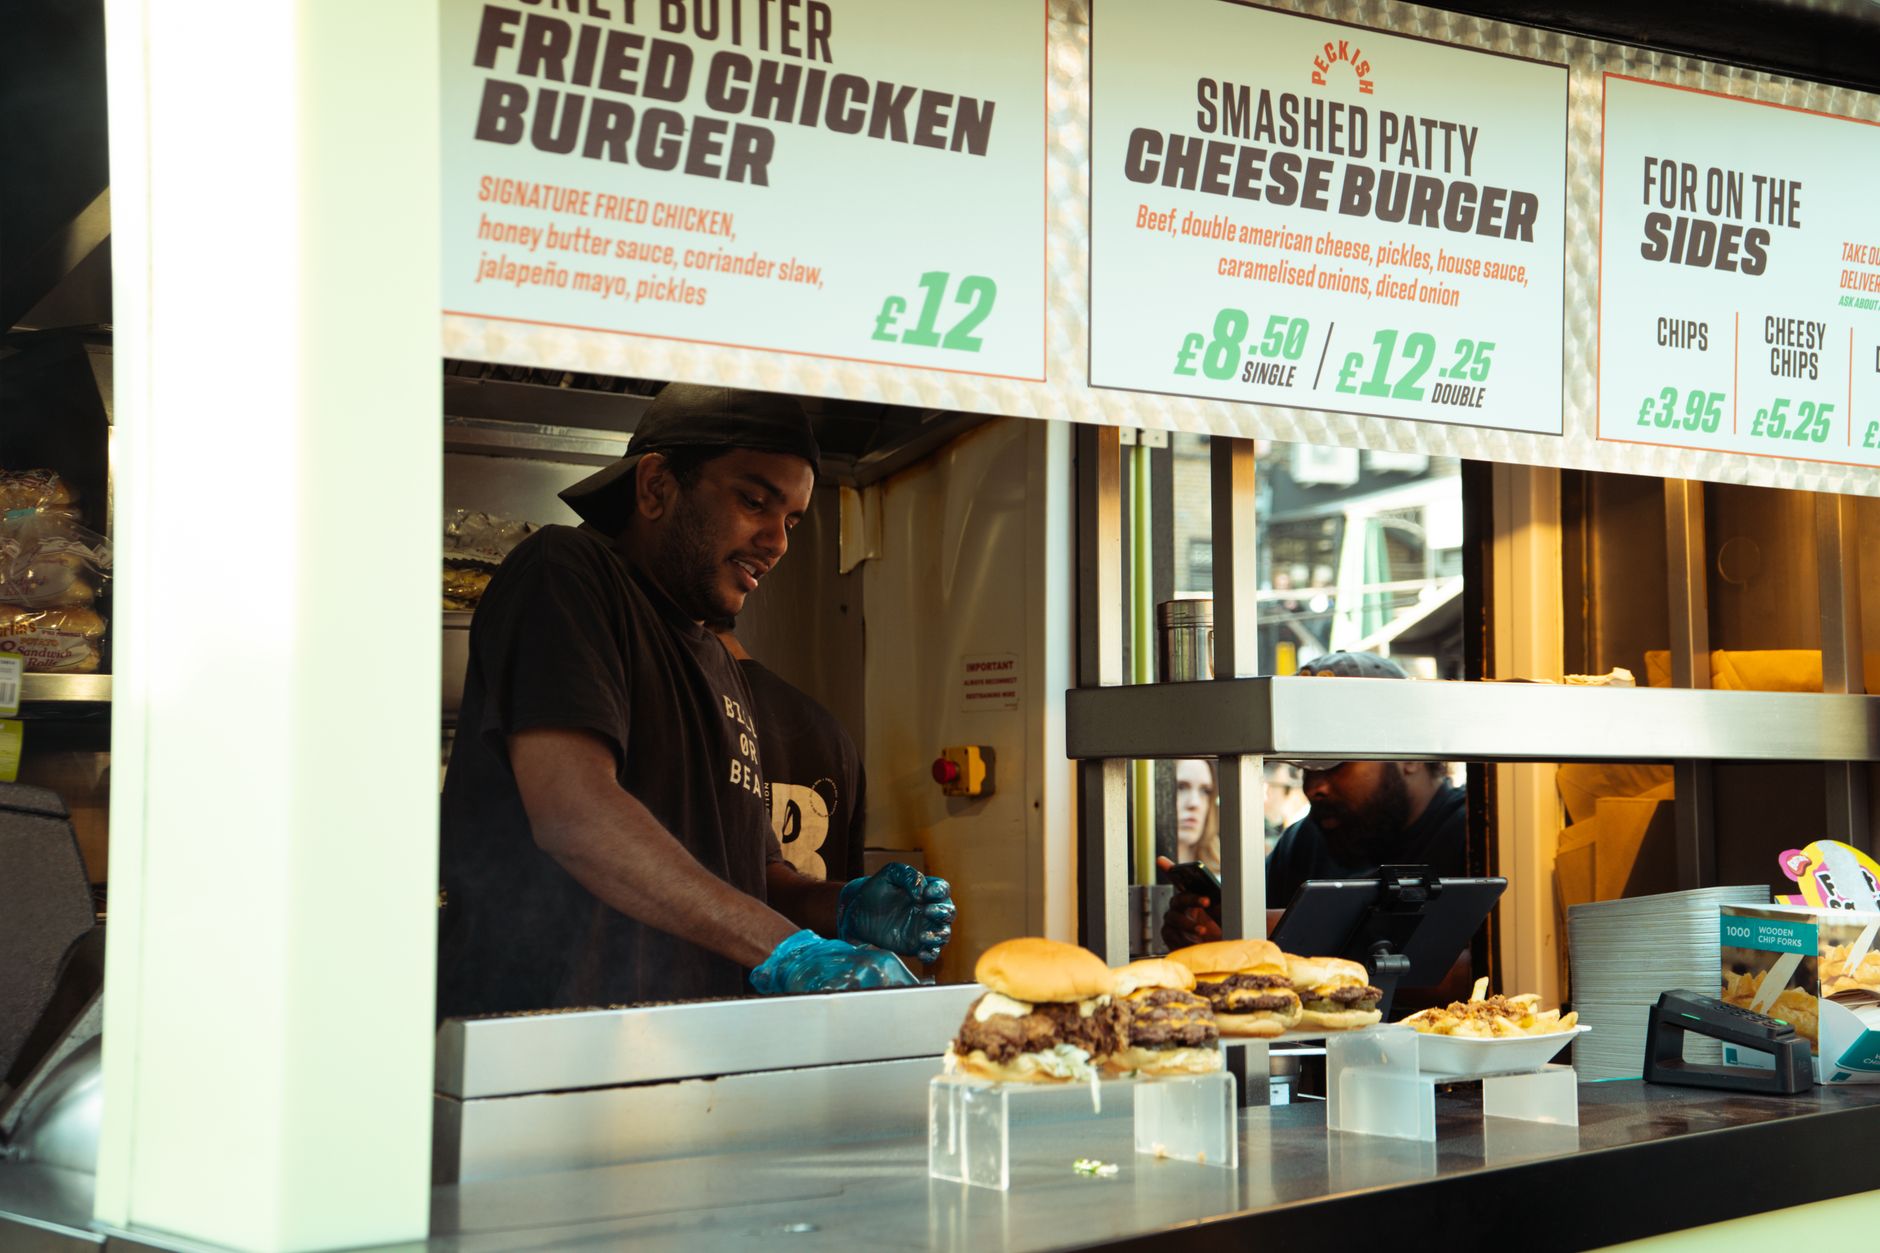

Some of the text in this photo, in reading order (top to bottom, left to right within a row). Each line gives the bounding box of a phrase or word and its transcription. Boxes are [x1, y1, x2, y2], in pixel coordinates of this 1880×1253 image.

[660, 0, 833, 64] BUTTER
[473, 4, 996, 157] FRIED CHICKEN
[1311, 40, 1374, 95] PECKISH
[473, 77, 776, 187] BURGER
[1197, 77, 1479, 177] SMASHED PATTY
[478, 175, 736, 241] SIGNATURE FRIED CHICKEN,
[1124, 127, 1539, 243] CHEESE BURGER
[1643, 156, 1802, 229] FOR ON THE
[478, 213, 824, 289] honey butter sauce, coriander slaw,
[1136, 203, 1528, 287] Beef, double american cheese, pickles, house sauce,
[1641, 212, 1771, 276] SIDES
[1841, 242, 1868, 265] TAKE
[475, 253, 707, 306] jalapeño mayo, pickles
[1218, 257, 1460, 307] caramelised onions, diced onion
[1838, 296, 1879, 311] ASK ABOUT
[872, 271, 997, 352] £12
[1657, 317, 1708, 351] CHIPS
[1765, 315, 1827, 350] CHEESY
[1174, 308, 1309, 381] £8.50
[1336, 329, 1495, 401] £12.25
[1770, 347, 1818, 380] CHIPS
[1242, 361, 1297, 387] SINGLE
[1431, 383, 1486, 408] DOUBLE
[1637, 386, 1726, 433] £3.95
[1750, 398, 1835, 443] £5.25
[965, 660, 1014, 672] IMPORTANT
[740, 733, 758, 765] OR
[1726, 925, 1751, 938] 1000
[1758, 926, 1794, 937] WOODEN
[1758, 935, 1802, 947] CHIP FORKS
